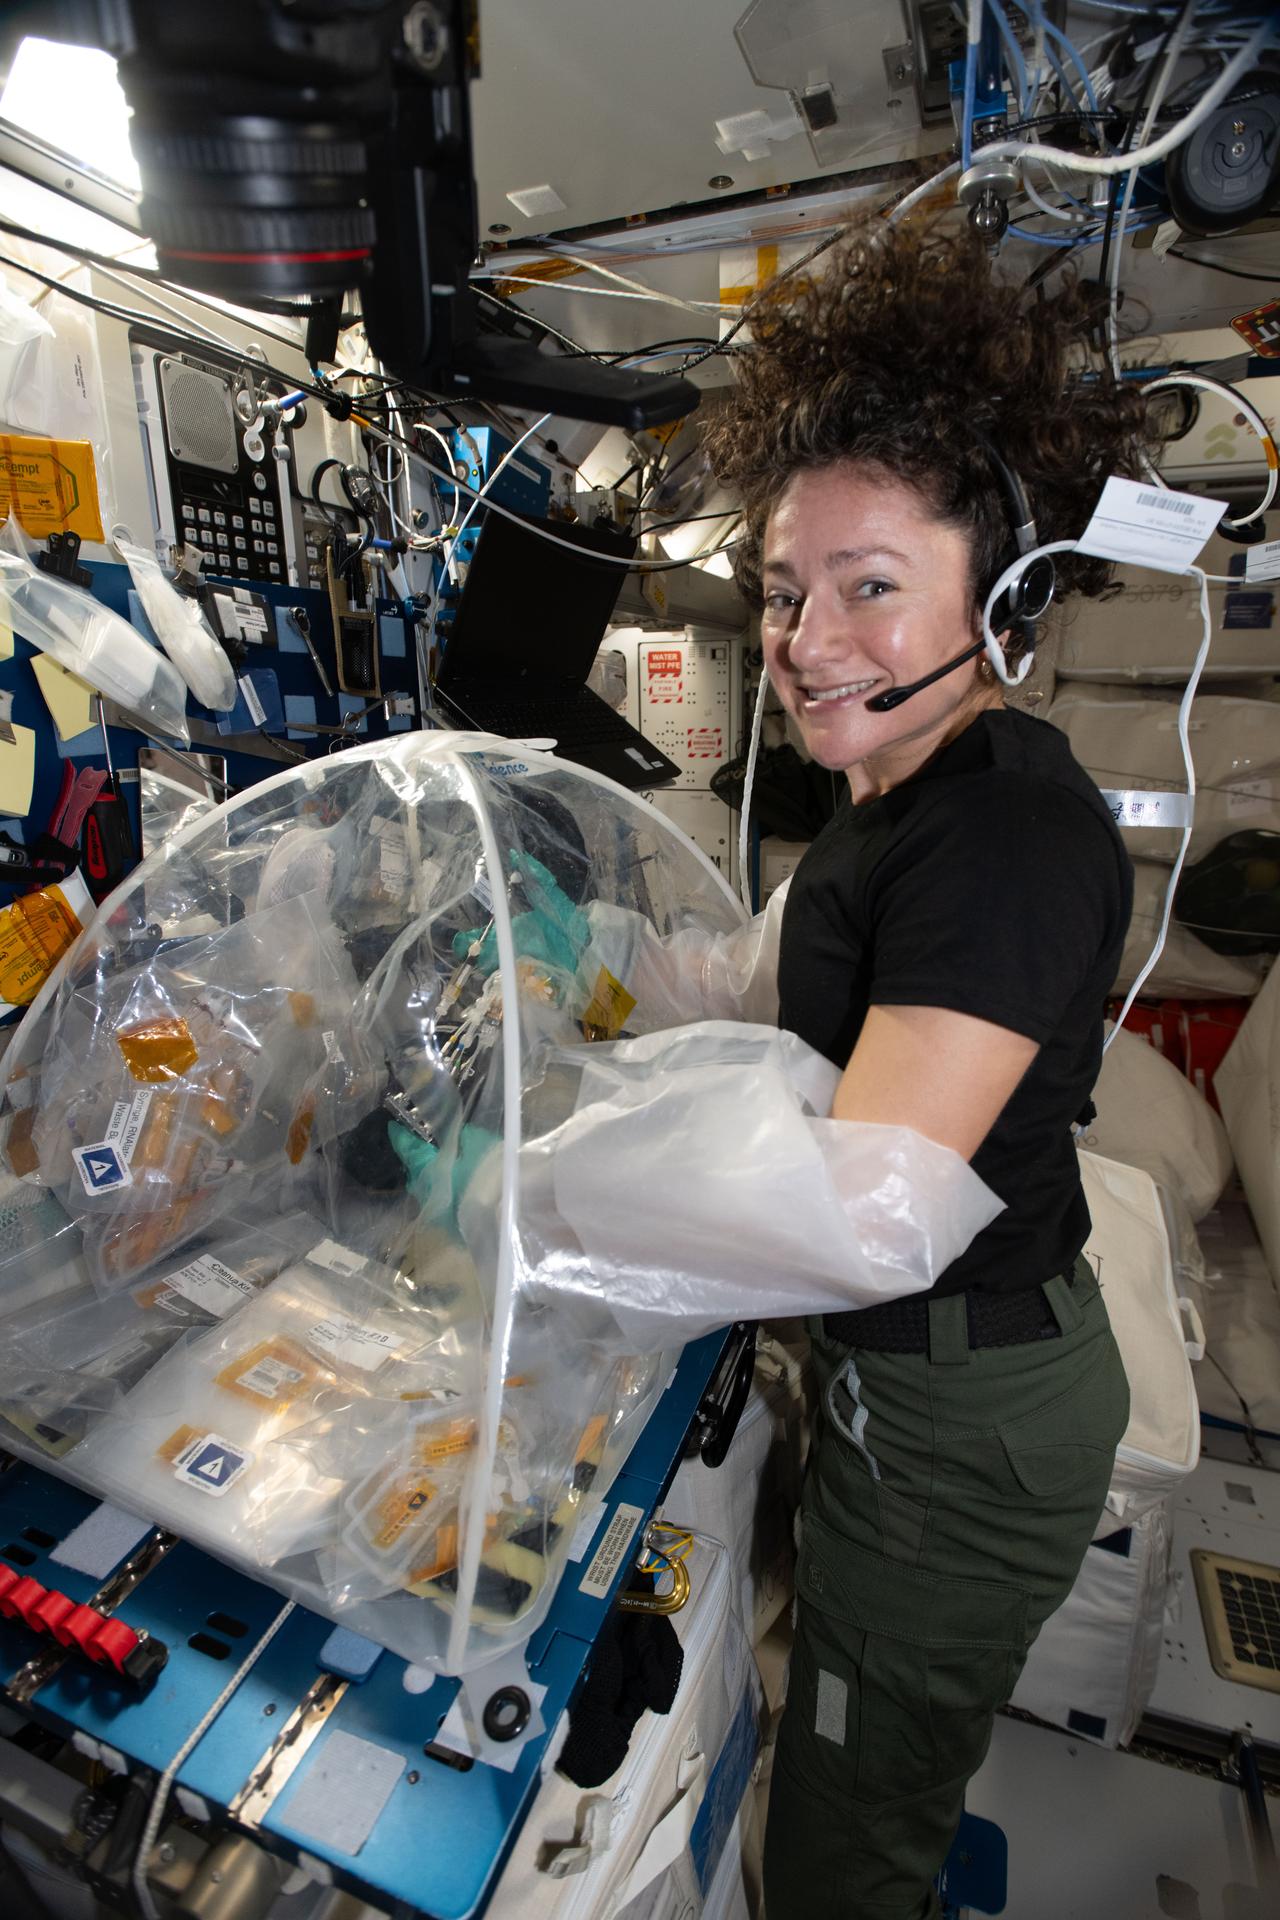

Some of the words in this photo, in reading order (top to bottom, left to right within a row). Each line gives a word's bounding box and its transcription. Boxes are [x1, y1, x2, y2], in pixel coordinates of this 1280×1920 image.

[649, 662, 667, 670] MIST
[111, 1104, 127, 1129] Waste
[130, 1091, 149, 1124] Syringe,
[208, 1462, 219, 1474] 1
[615, 1517, 629, 1536] WHEN
[587, 1560, 599, 1582] WRIST
[597, 1534, 614, 1562] GROUND
[609, 1513, 622, 1534] STRAP
[599, 1565, 613, 1587] USING
[609, 1550, 621, 1565] THIS
[616, 1516, 636, 1551] HARDWARE
[606, 1535, 620, 1556] WORN
[602, 1556, 611, 1565] BE
[593, 1565, 605, 1584] MUST
